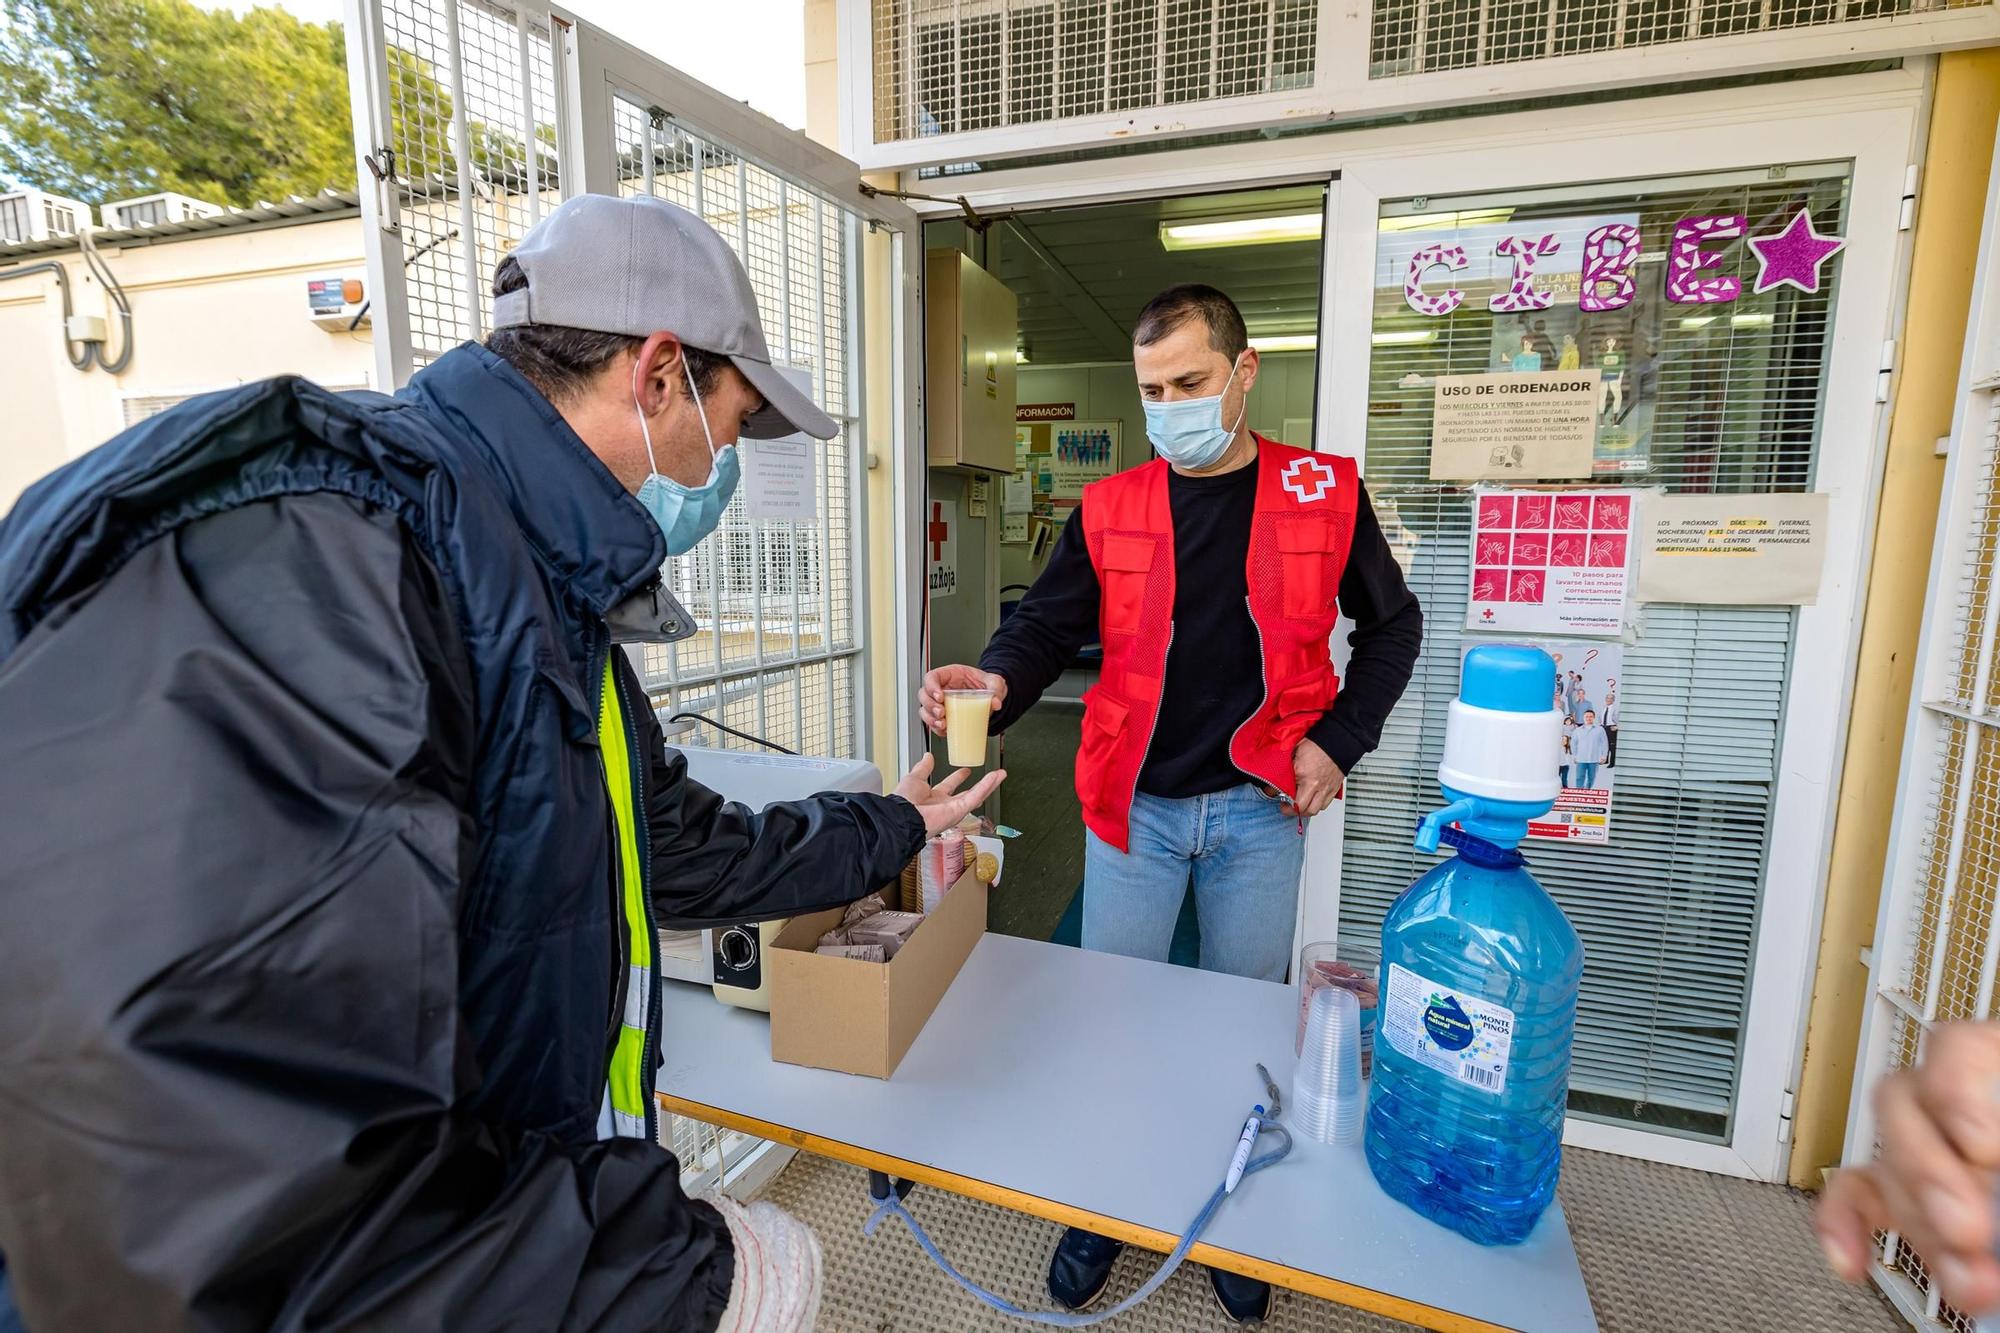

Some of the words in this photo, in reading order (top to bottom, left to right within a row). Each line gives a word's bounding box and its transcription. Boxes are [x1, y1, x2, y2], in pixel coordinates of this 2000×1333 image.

[1404, 215, 1748, 316] CIBE
[1442, 386, 1472, 396] USO
[1476, 385, 1494, 394] DE
[1500, 382, 1591, 394] ORDENADOR
[1016, 406, 1074, 416] NFORMACIÓN
[1428, 1010, 1445, 1020] Agua
[1446, 1018, 1470, 1030] mineral
[1428, 1016, 1450, 1029] natural
[1480, 1014, 1510, 1028] MONTE
[1483, 1022, 1510, 1034] PINOS
